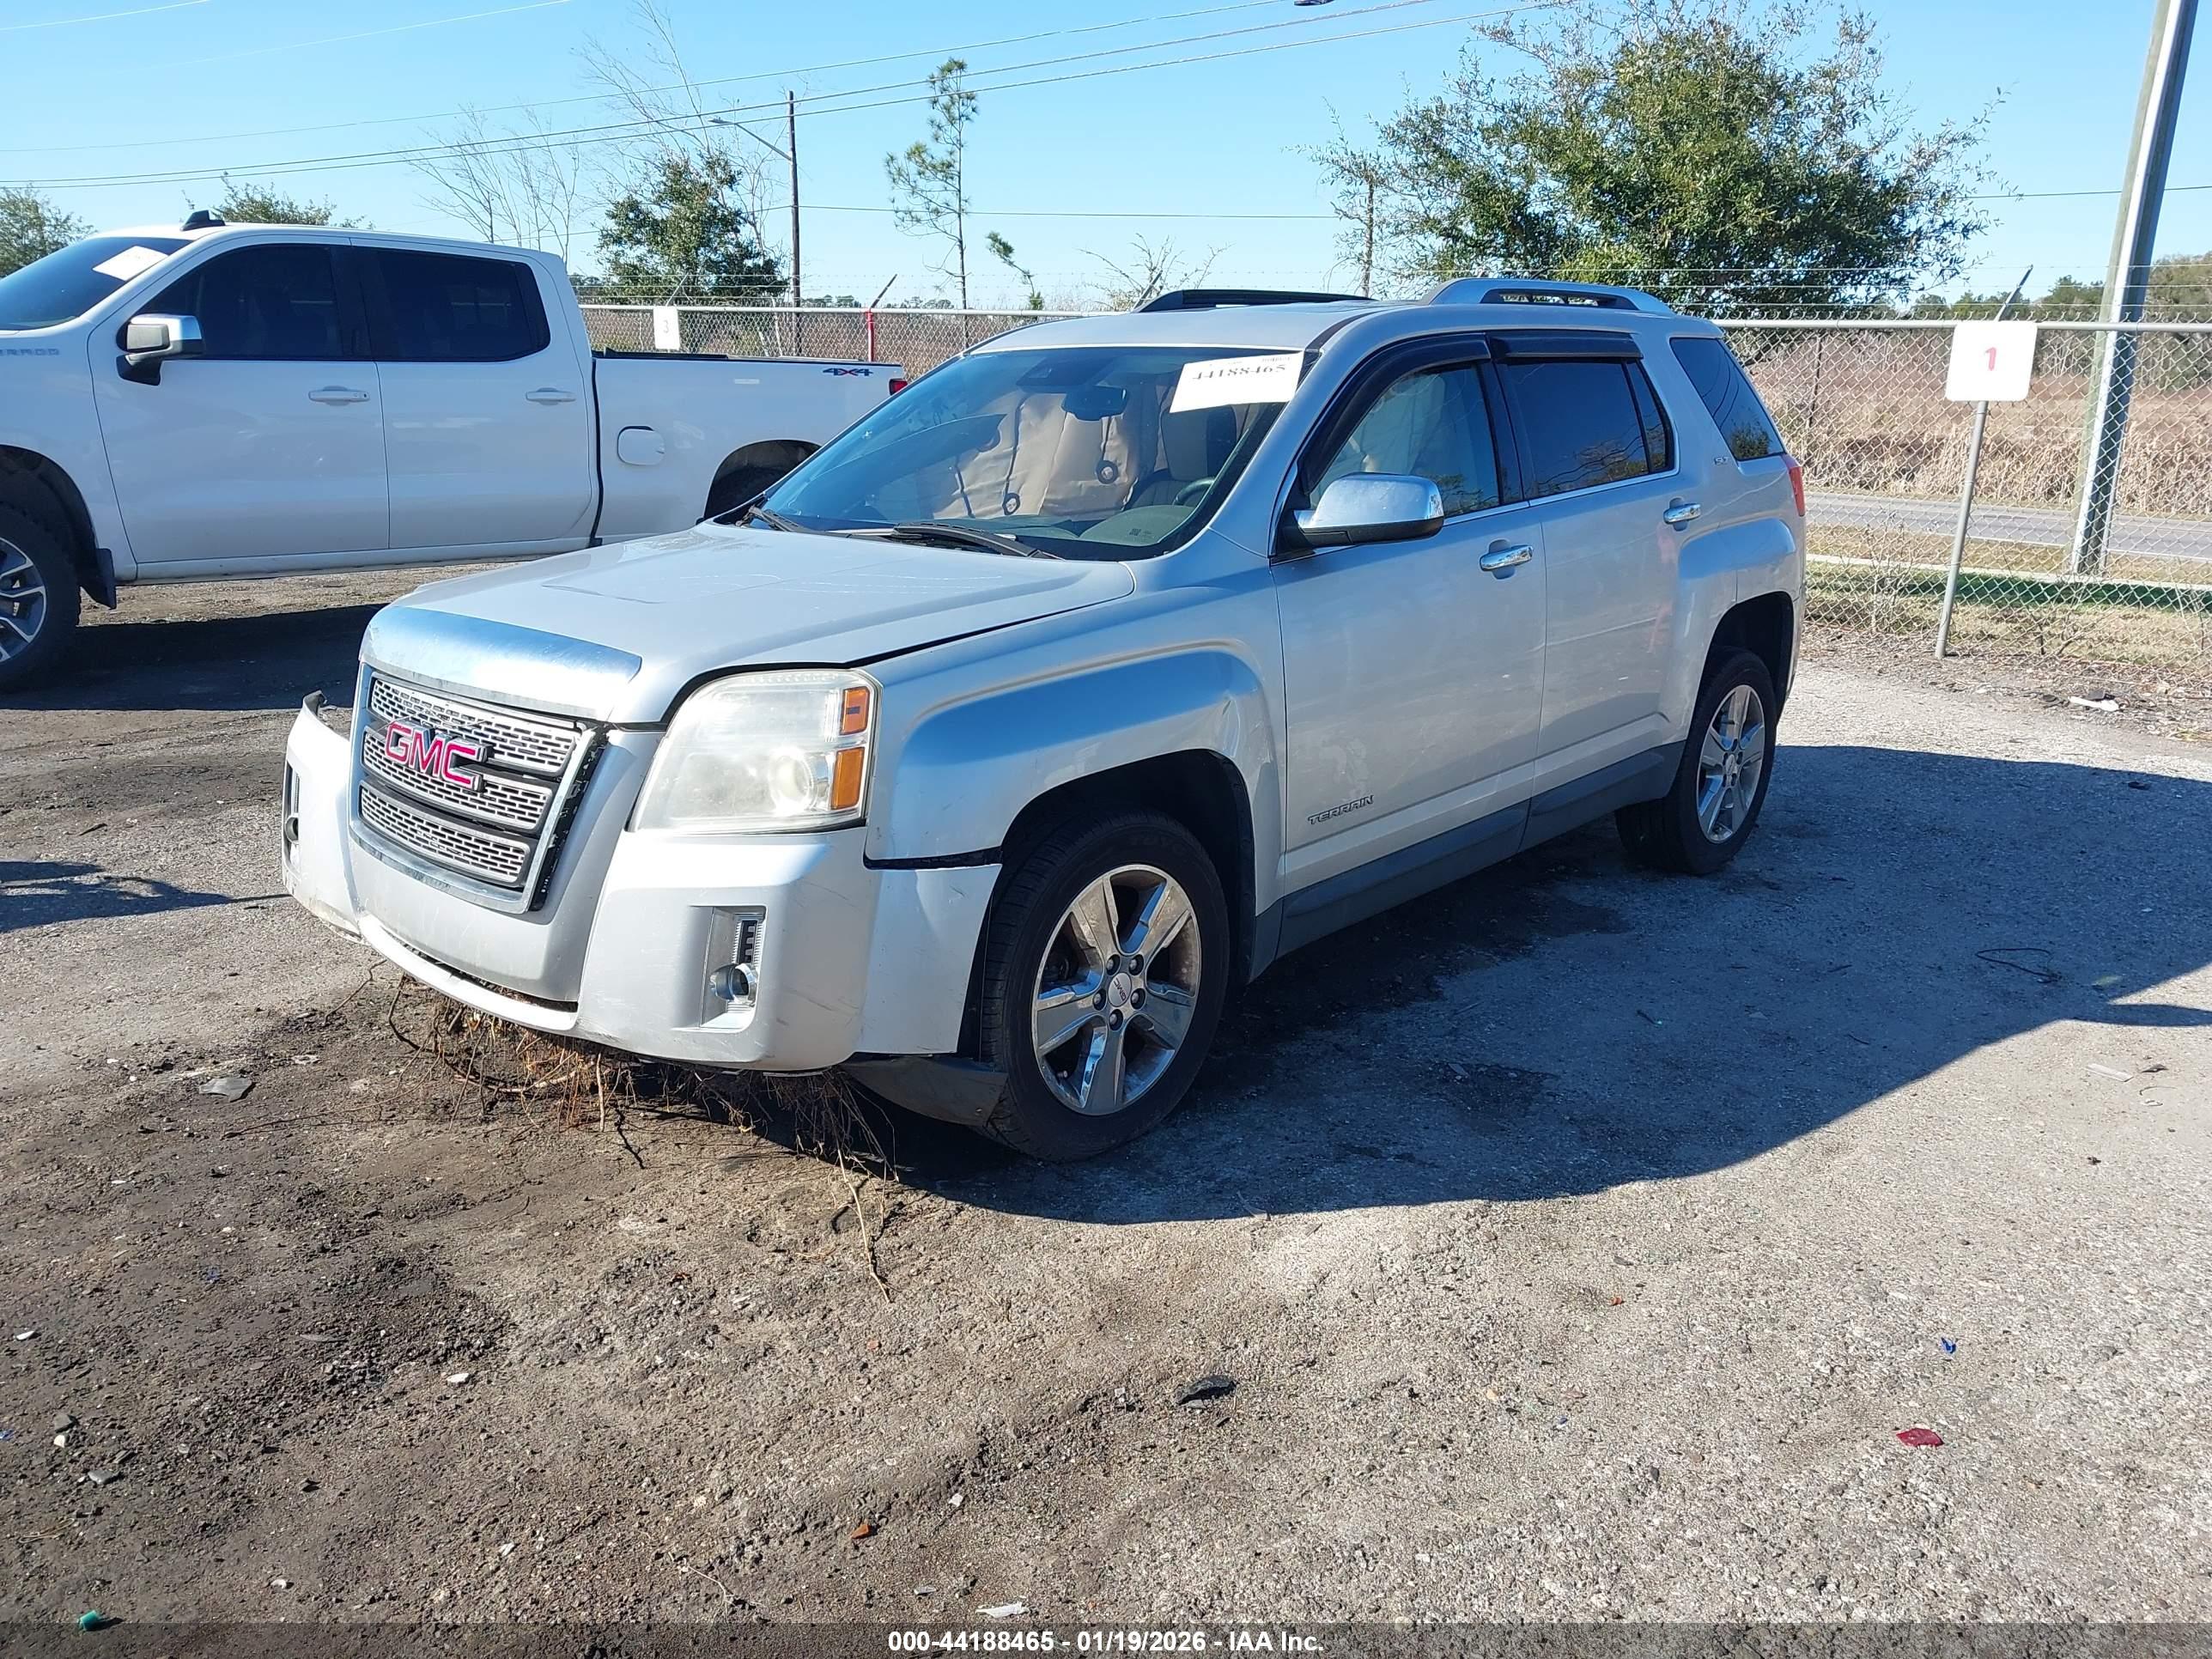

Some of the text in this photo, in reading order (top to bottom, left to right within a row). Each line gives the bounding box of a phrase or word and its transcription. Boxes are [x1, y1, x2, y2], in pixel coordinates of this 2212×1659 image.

[663, 319, 670, 334] 3
[1192, 364, 1286, 380] 44188465
[1984, 347, 1997, 372] 1
[384, 720, 486, 791] GMC
[1307, 794, 1375, 825] TERRAIN
